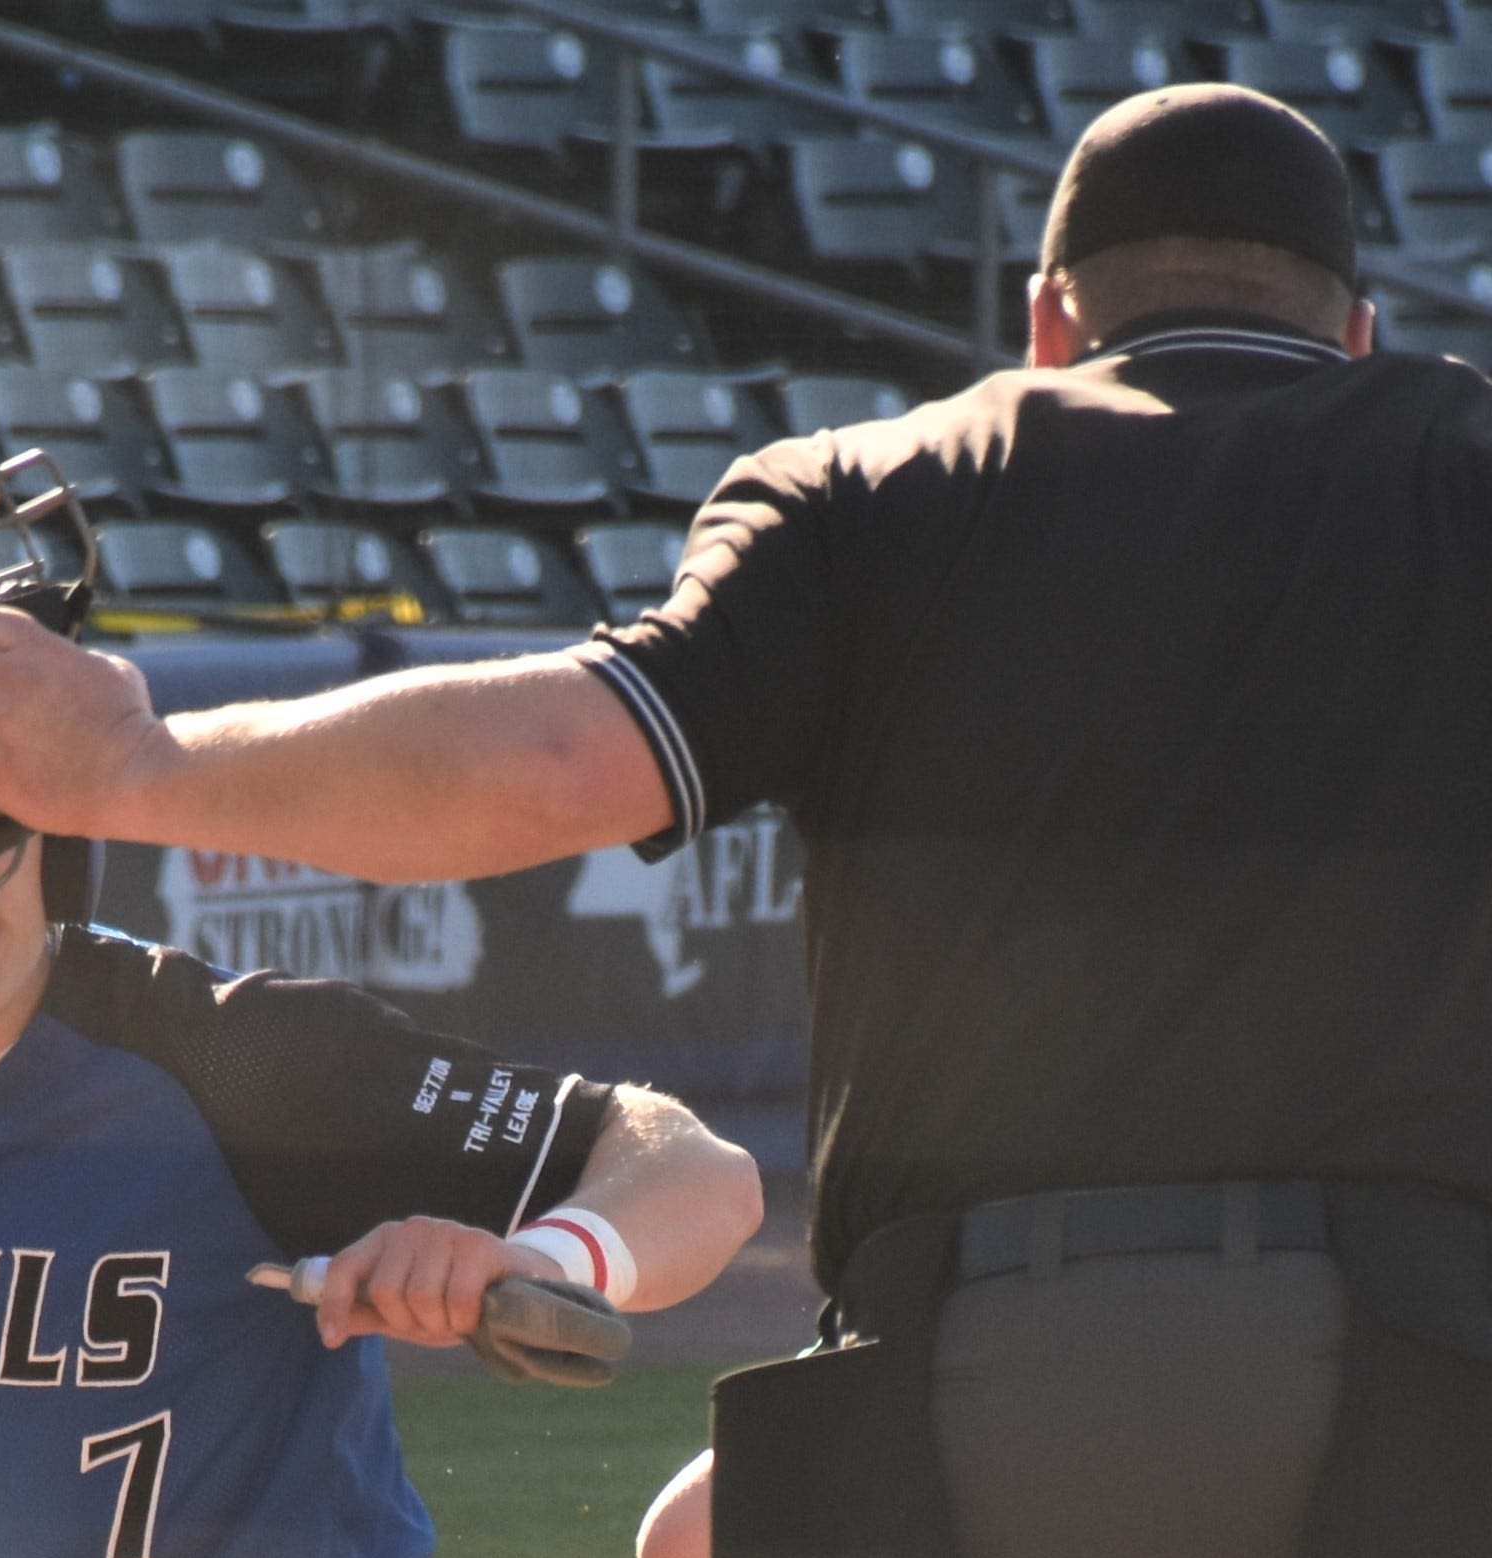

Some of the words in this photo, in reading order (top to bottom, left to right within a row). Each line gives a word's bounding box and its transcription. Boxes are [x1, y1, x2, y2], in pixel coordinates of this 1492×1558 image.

[666, 820, 804, 928] AFL
[194, 886, 444, 977] STRONG!
[412, 1057, 452, 1114] SECTION
[463, 1068, 514, 1152] TRI-VALLEY
